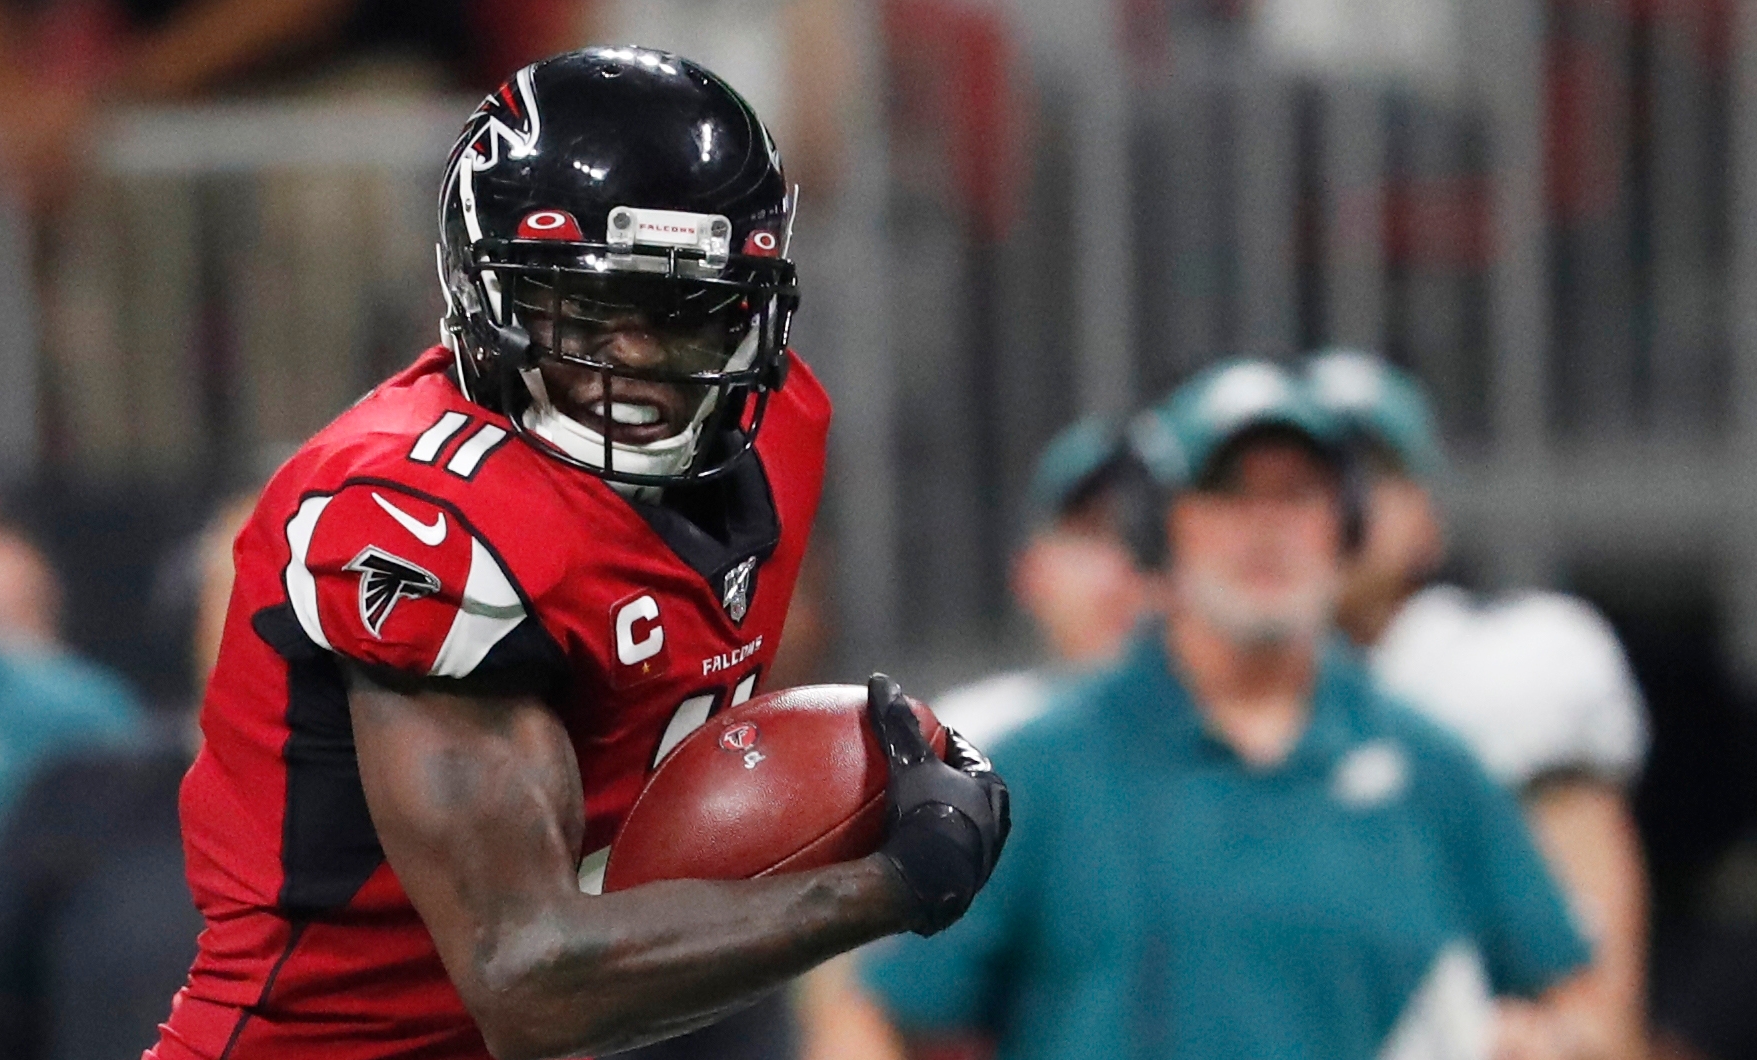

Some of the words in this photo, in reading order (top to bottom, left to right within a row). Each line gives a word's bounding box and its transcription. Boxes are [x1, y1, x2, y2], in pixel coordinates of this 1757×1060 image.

[639, 223, 695, 234] FALCONS
[407, 409, 511, 481] 11
[616, 595, 664, 665] C
[702, 636, 763, 676] FALCONS
